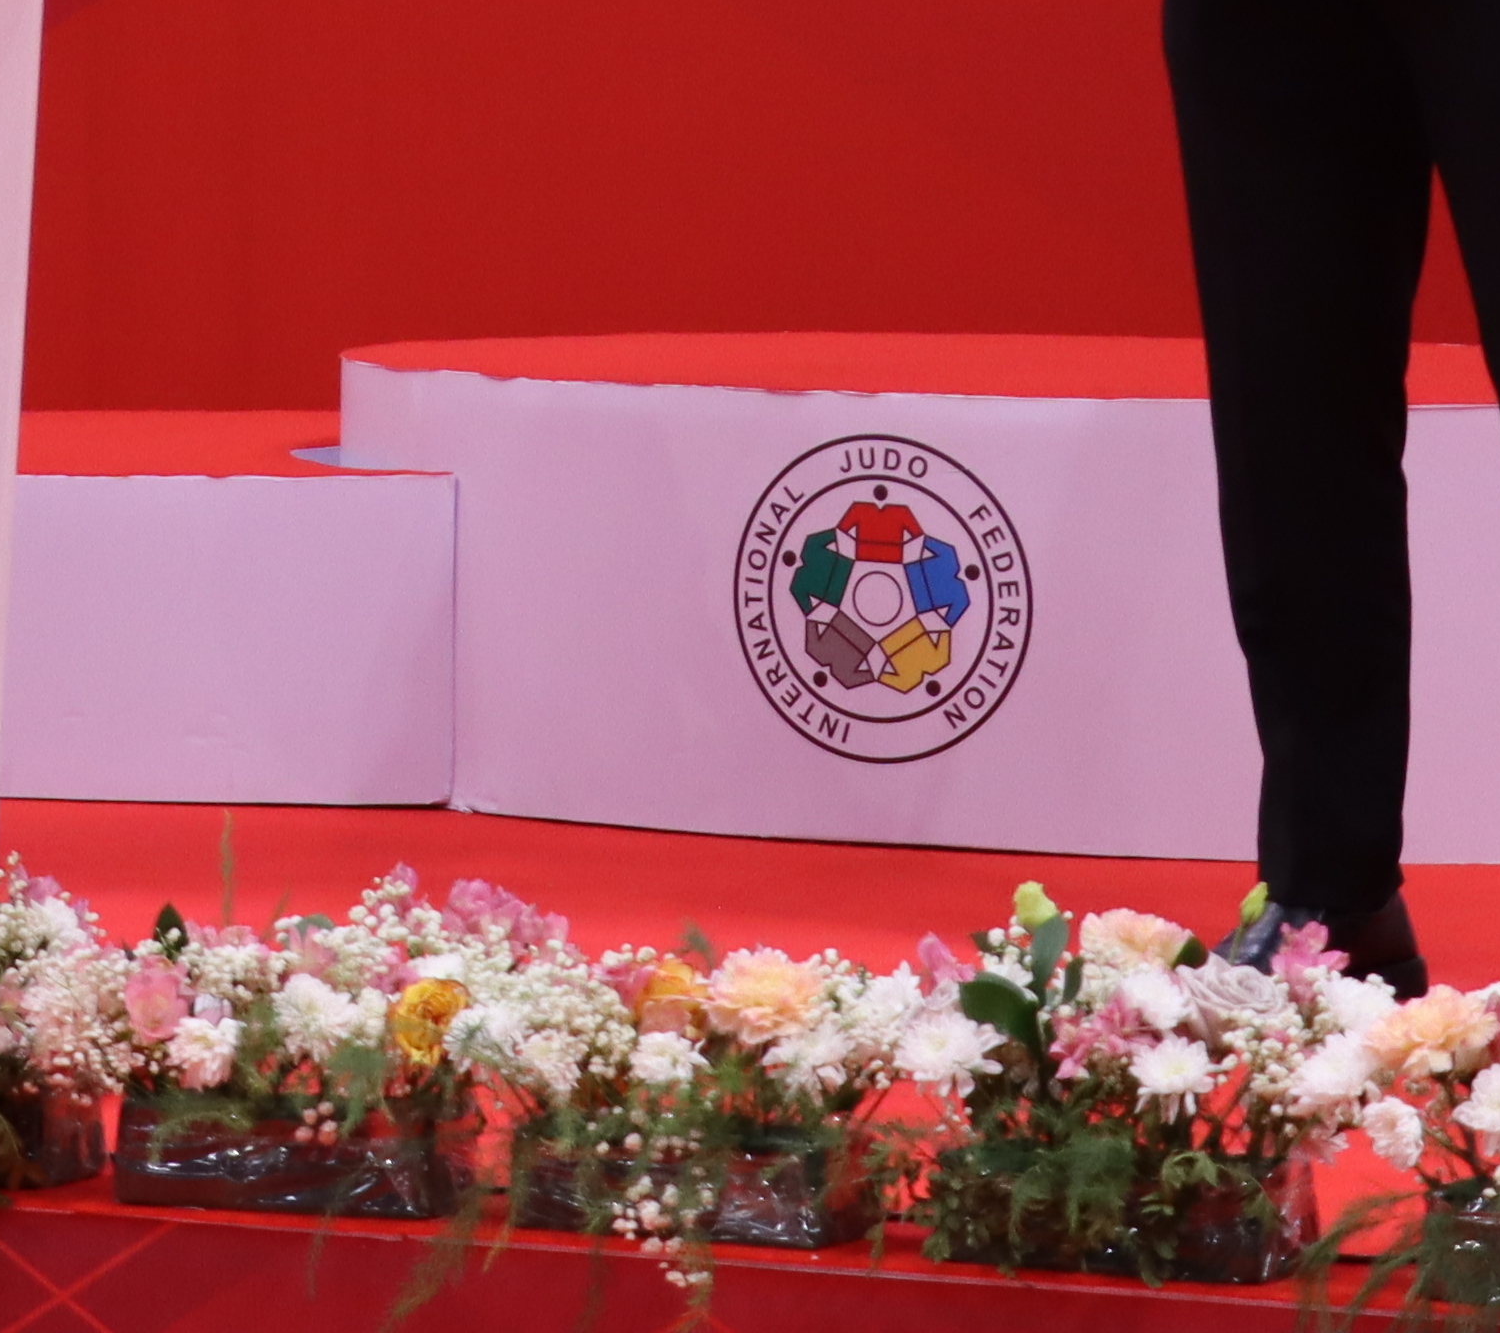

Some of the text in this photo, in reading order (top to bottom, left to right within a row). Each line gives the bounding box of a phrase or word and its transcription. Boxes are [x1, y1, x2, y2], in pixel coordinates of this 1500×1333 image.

[840, 447, 929, 478] JUDO
[745, 485, 850, 744] INTERNATIONAL
[942, 504, 1021, 730] FEDERATION
